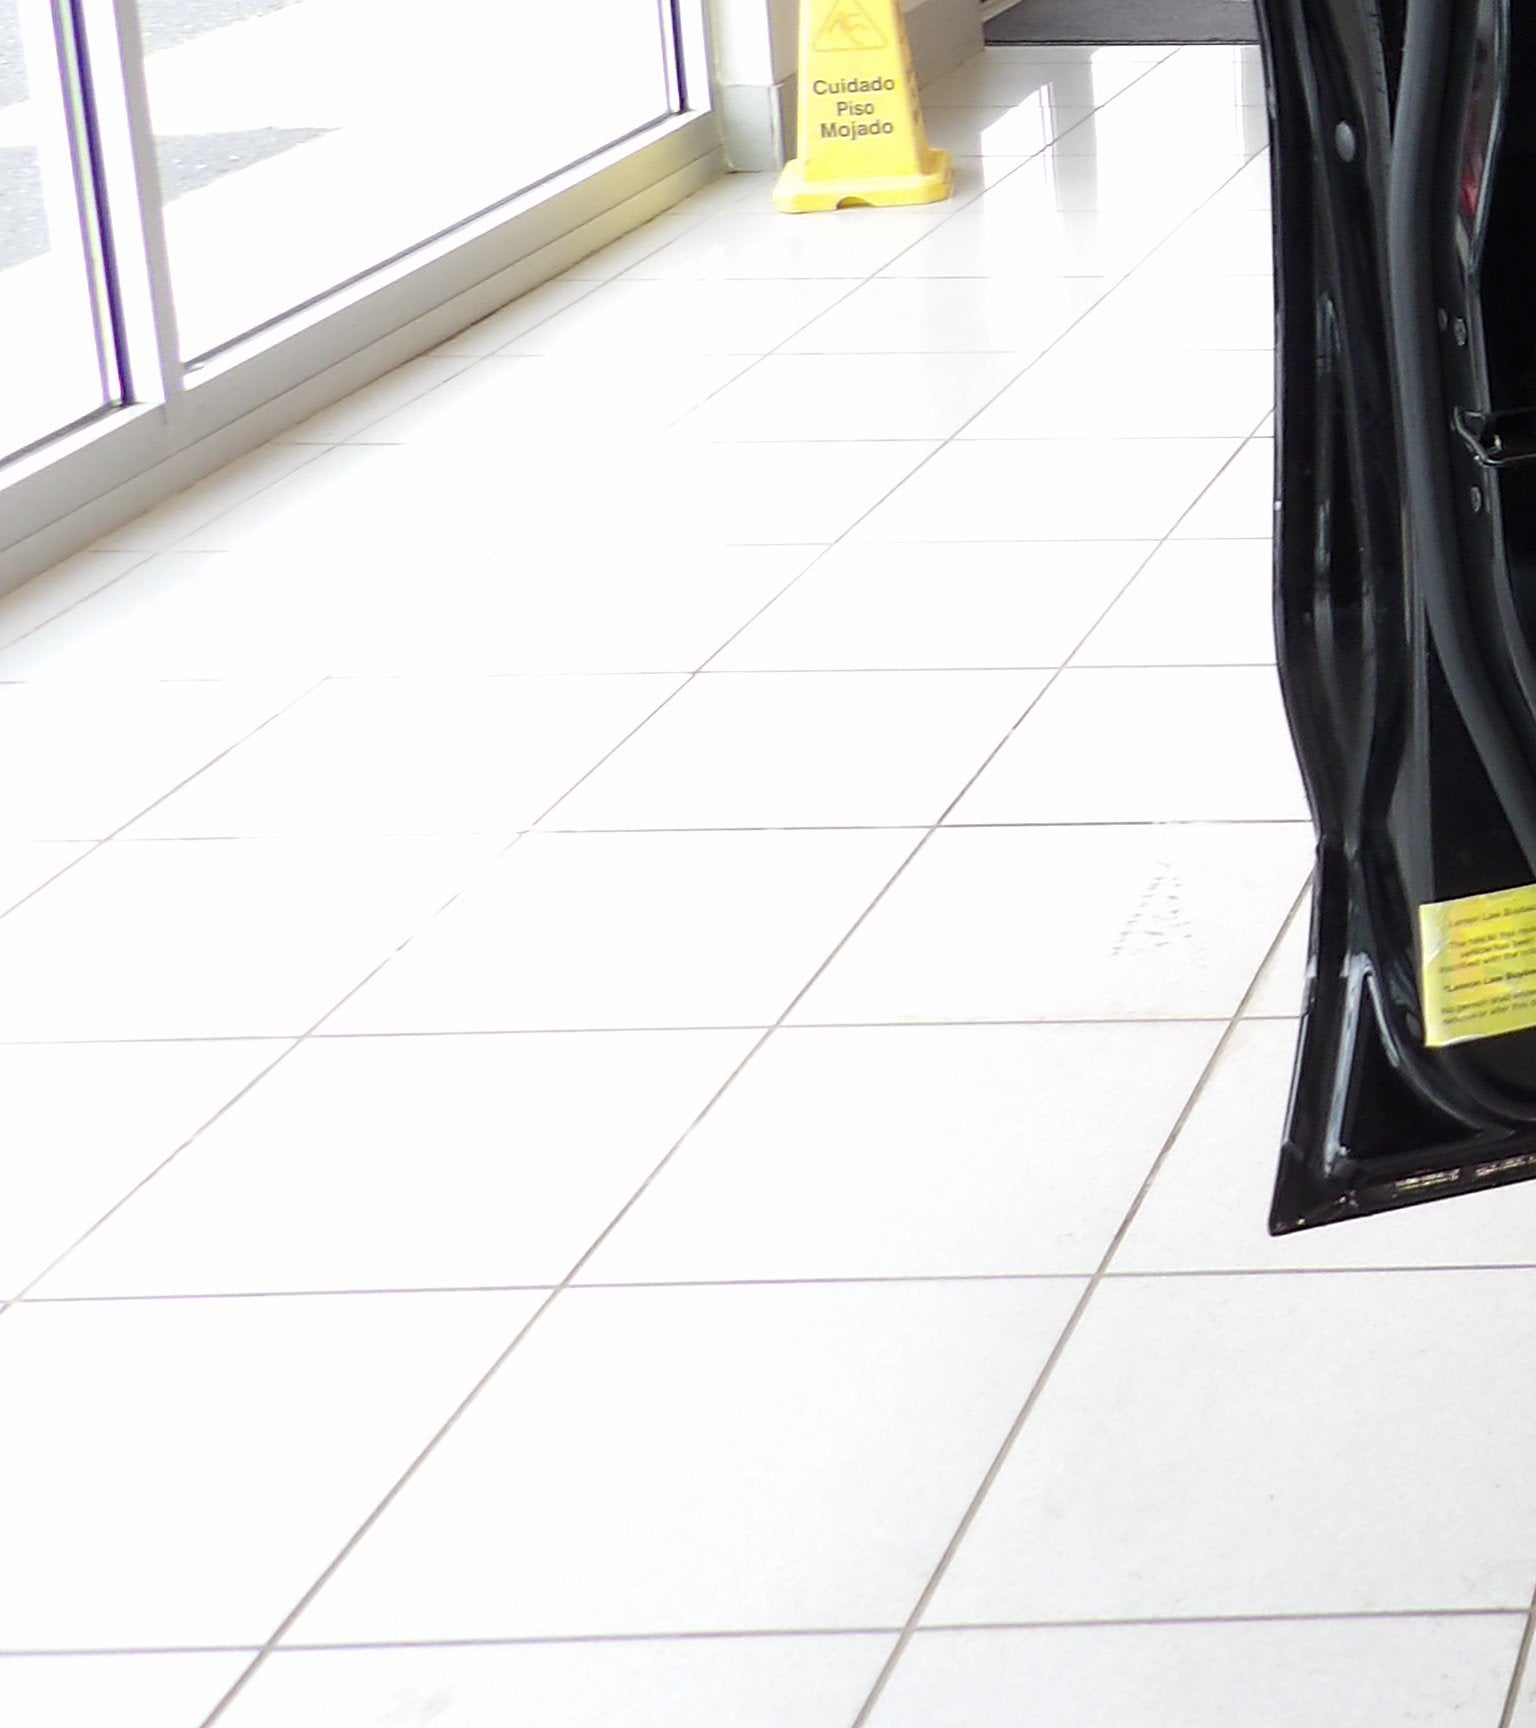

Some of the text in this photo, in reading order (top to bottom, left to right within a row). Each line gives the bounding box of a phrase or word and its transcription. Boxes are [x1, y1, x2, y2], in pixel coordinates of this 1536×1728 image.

[813, 76, 895, 95] Cuidado
[836, 100, 875, 116] Piso
[820, 119, 894, 141] Mojado
